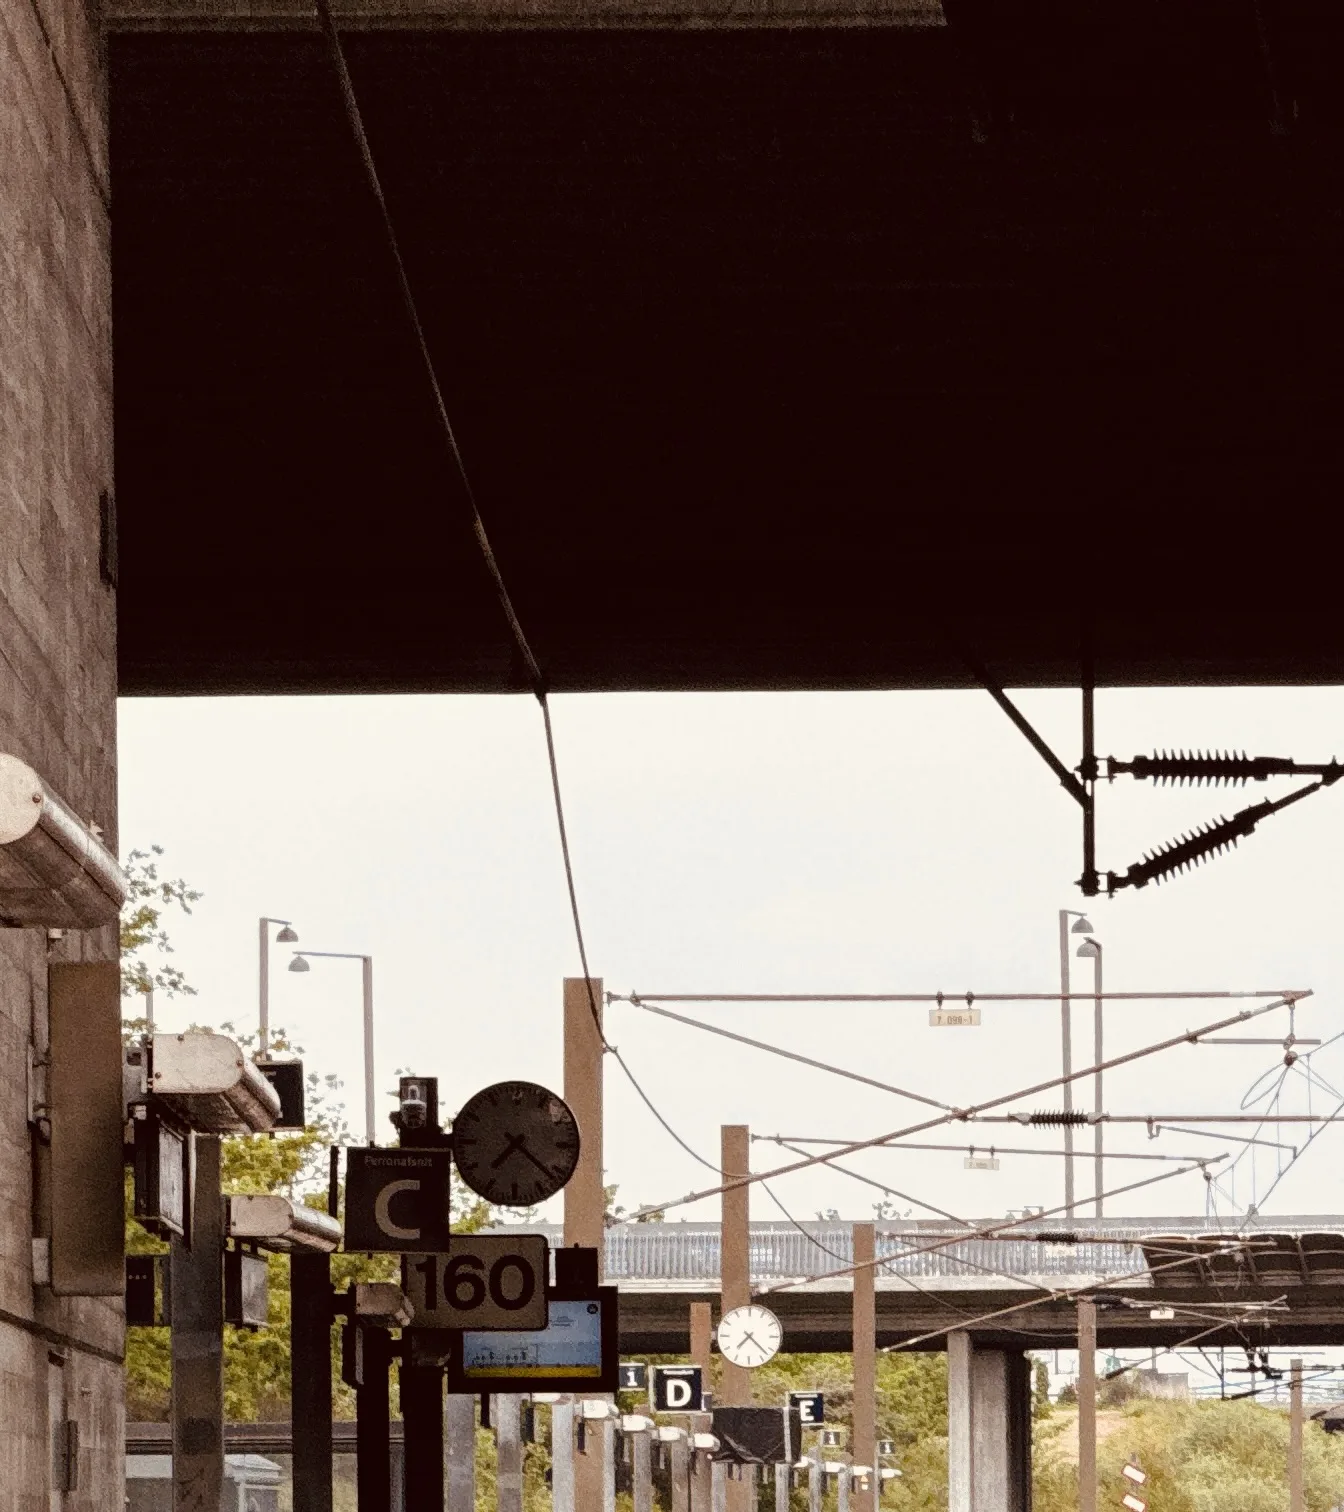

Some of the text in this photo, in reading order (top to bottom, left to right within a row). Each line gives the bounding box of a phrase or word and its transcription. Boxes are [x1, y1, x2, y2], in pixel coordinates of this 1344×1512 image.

[375, 1179, 420, 1240] C
[414, 1254, 535, 1311] 160
[626, 1370, 639, 1387] 1
[666, 1379, 692, 1408] D
[799, 1400, 815, 1422] E
[828, 1433, 836, 1445] 1
